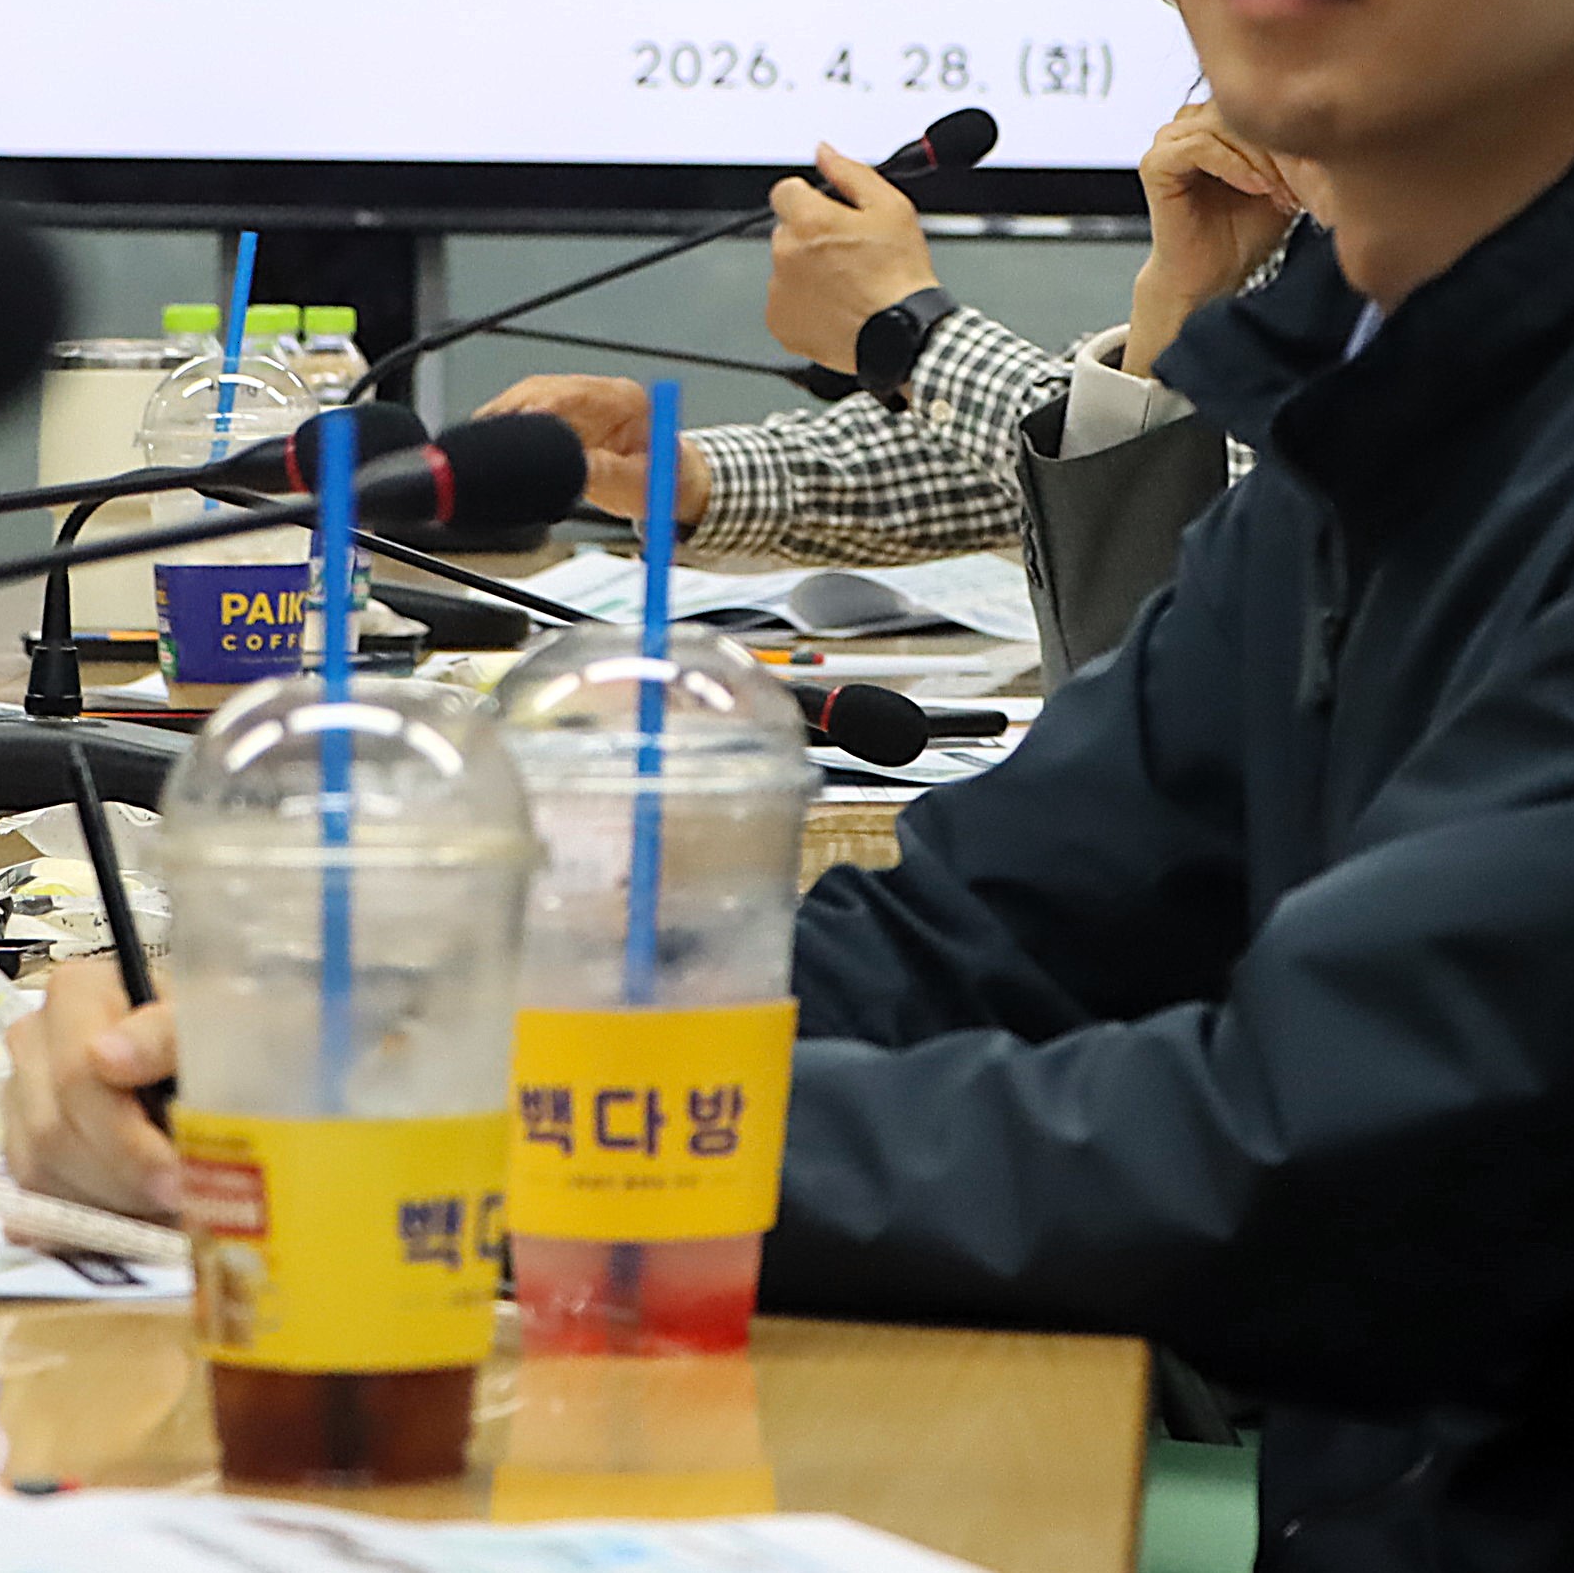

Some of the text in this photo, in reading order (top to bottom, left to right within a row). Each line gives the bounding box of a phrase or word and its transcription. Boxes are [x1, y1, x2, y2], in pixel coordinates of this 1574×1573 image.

[633, 40, 1115, 98] 2026. 4. 28. (화)
[220, 633, 304, 652] COFF
[520, 1083, 744, 1159] 백다방
